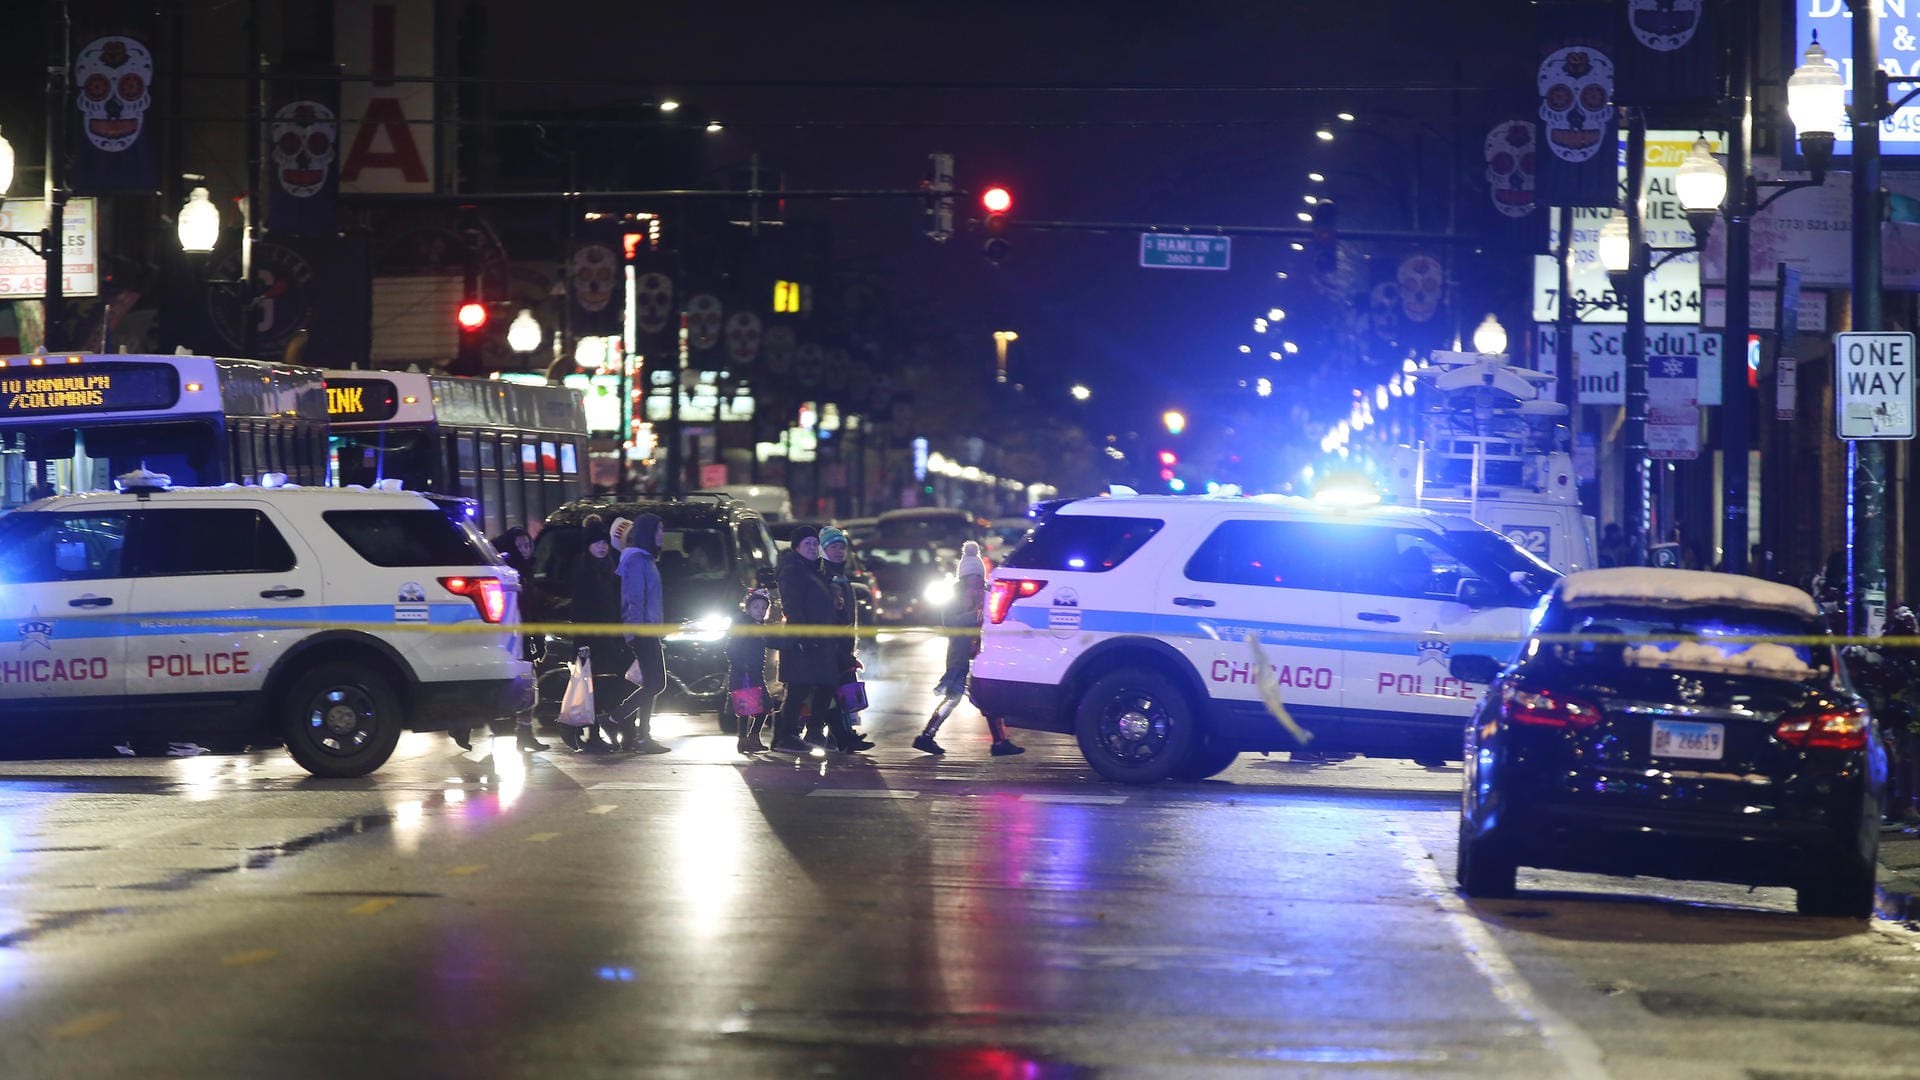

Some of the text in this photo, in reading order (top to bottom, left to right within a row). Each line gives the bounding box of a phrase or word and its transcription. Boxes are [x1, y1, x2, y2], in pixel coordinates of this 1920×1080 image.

[1892, 25, 1916, 50] &
[1157, 239, 1209, 252] HAMLIN
[1849, 342, 1904, 366] ONE
[25, 376, 111, 393] RANDOLPH
[1848, 372, 1905, 395] WAY
[0, 657, 107, 685] HICAGO
[148, 652, 249, 678] POLICE
[1211, 659, 1332, 690] CHIAGO
[1377, 672, 1477, 700] POLICE
